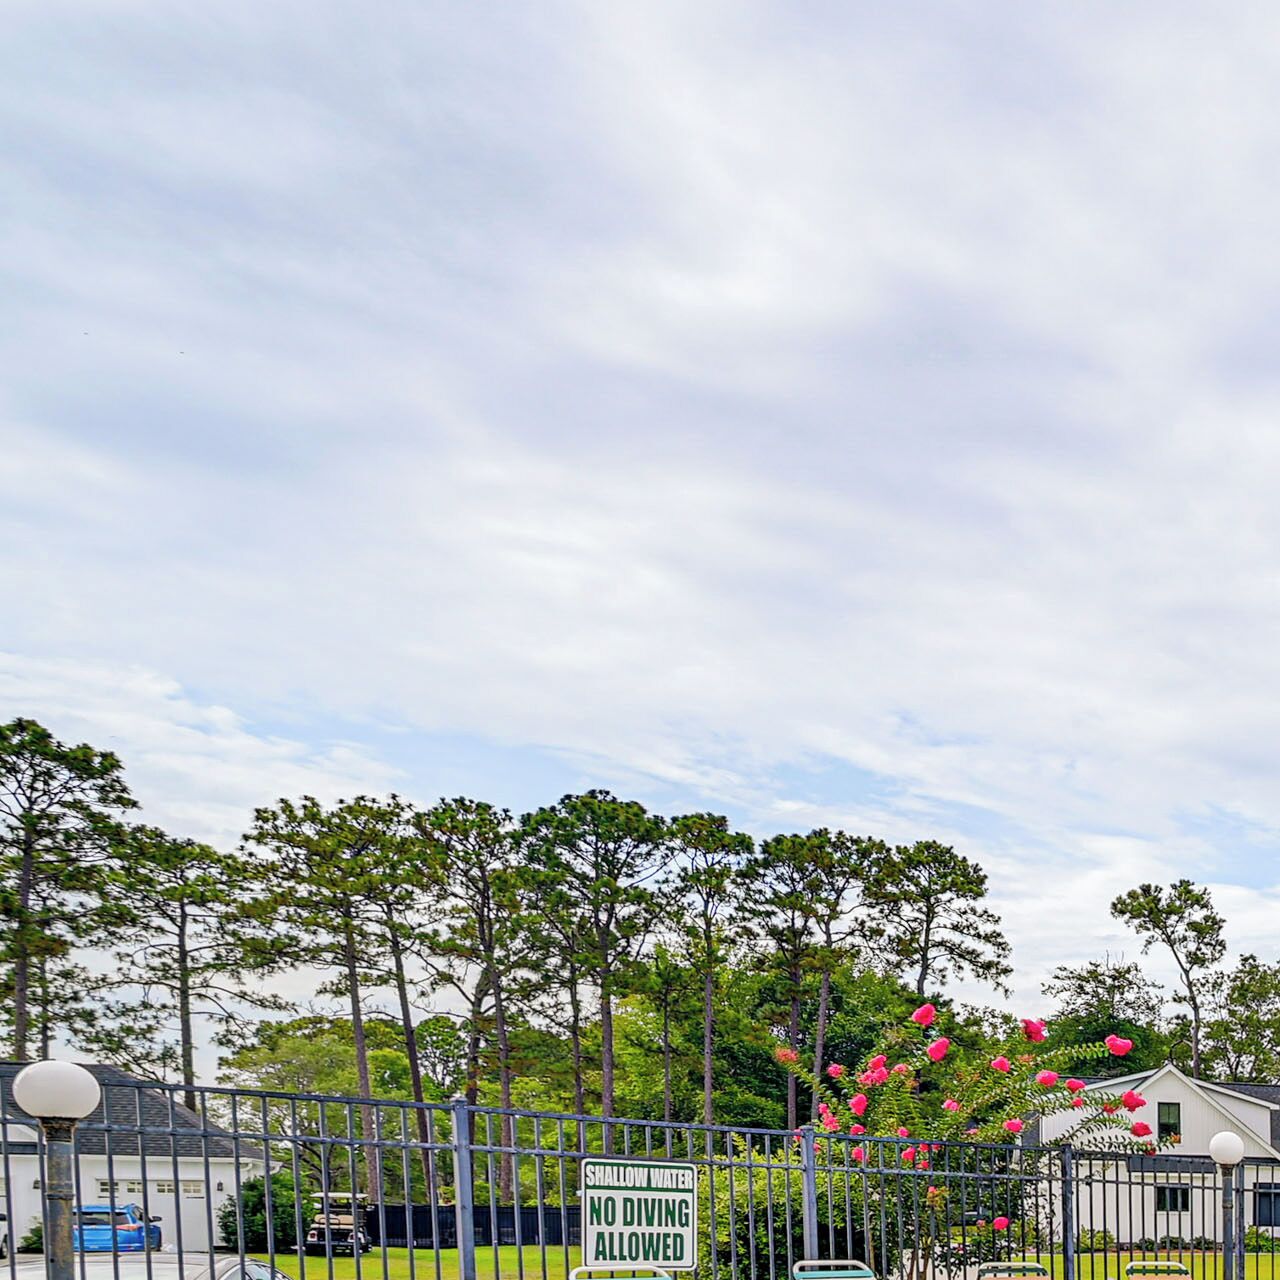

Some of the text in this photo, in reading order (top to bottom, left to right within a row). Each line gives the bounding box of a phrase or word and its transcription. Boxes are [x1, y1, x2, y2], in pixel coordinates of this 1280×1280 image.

[586, 1164, 693, 1190] SHALLOW WATER
[589, 1196, 690, 1229] NO DIVING
[594, 1231, 685, 1262] ALLOWED
